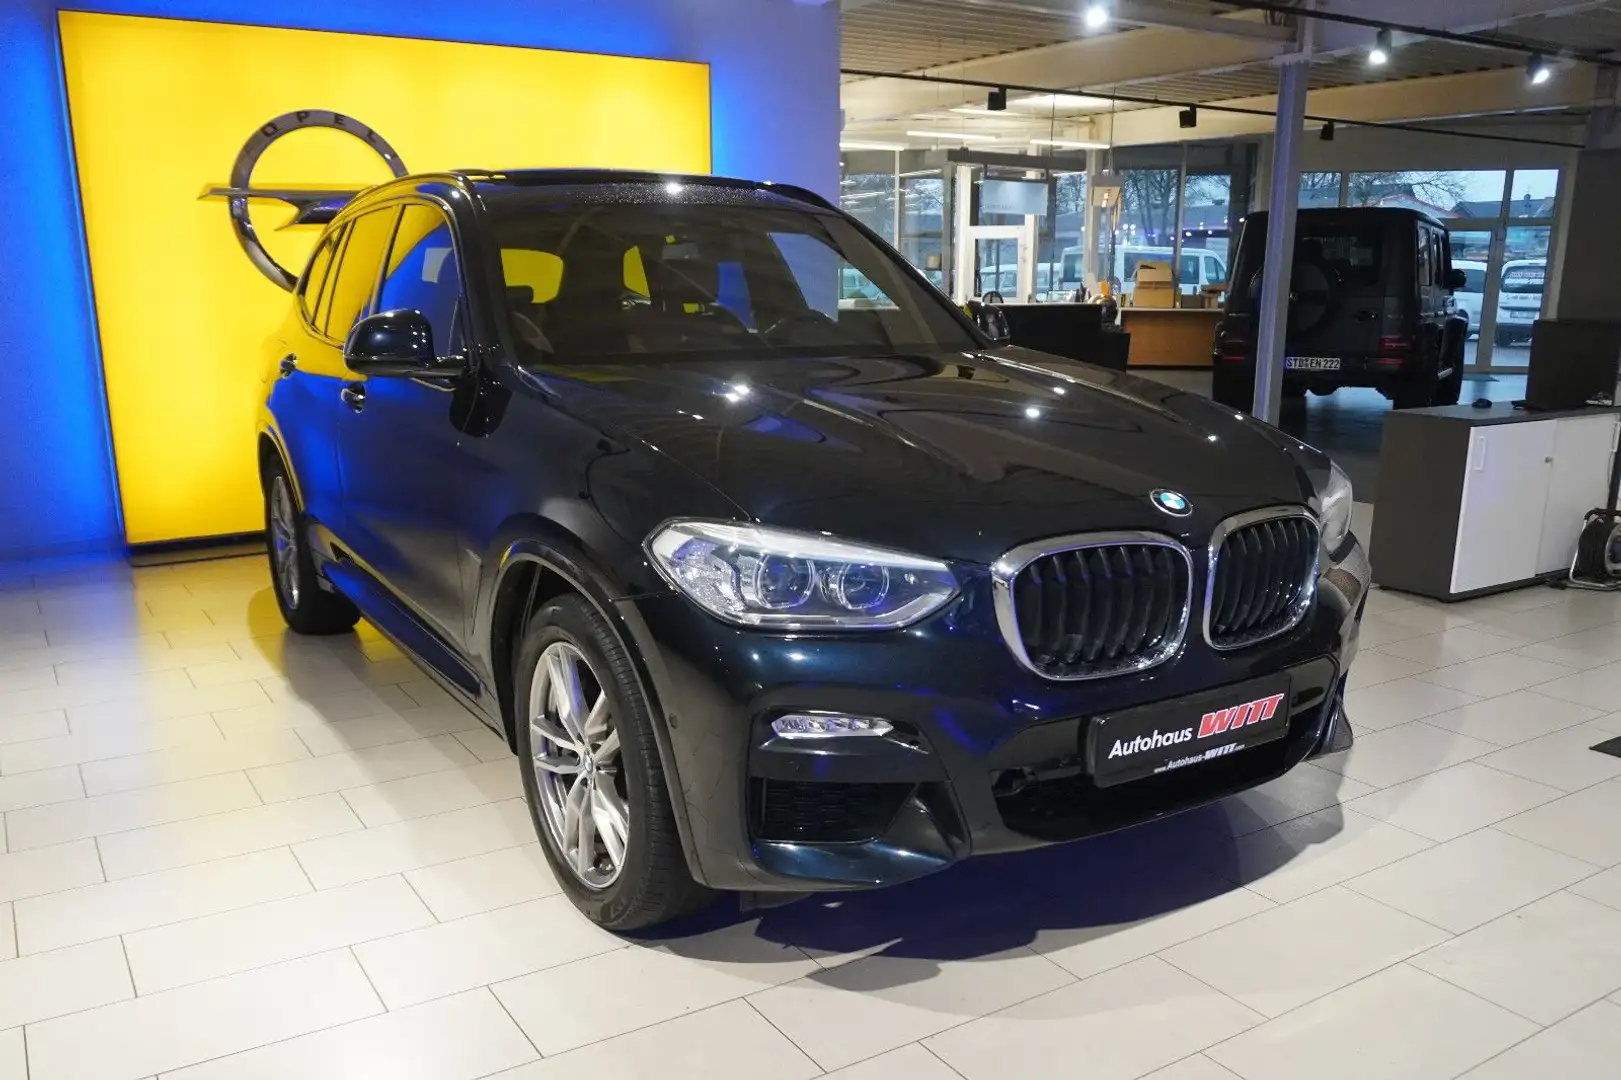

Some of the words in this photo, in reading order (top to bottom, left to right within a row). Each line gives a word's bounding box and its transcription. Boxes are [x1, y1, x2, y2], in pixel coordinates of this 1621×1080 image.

[261, 111, 378, 142] OPEL
[1323, 359, 1339, 369] 222
[1108, 726, 1193, 759] Autohaus
[1197, 693, 1285, 739] WITT
